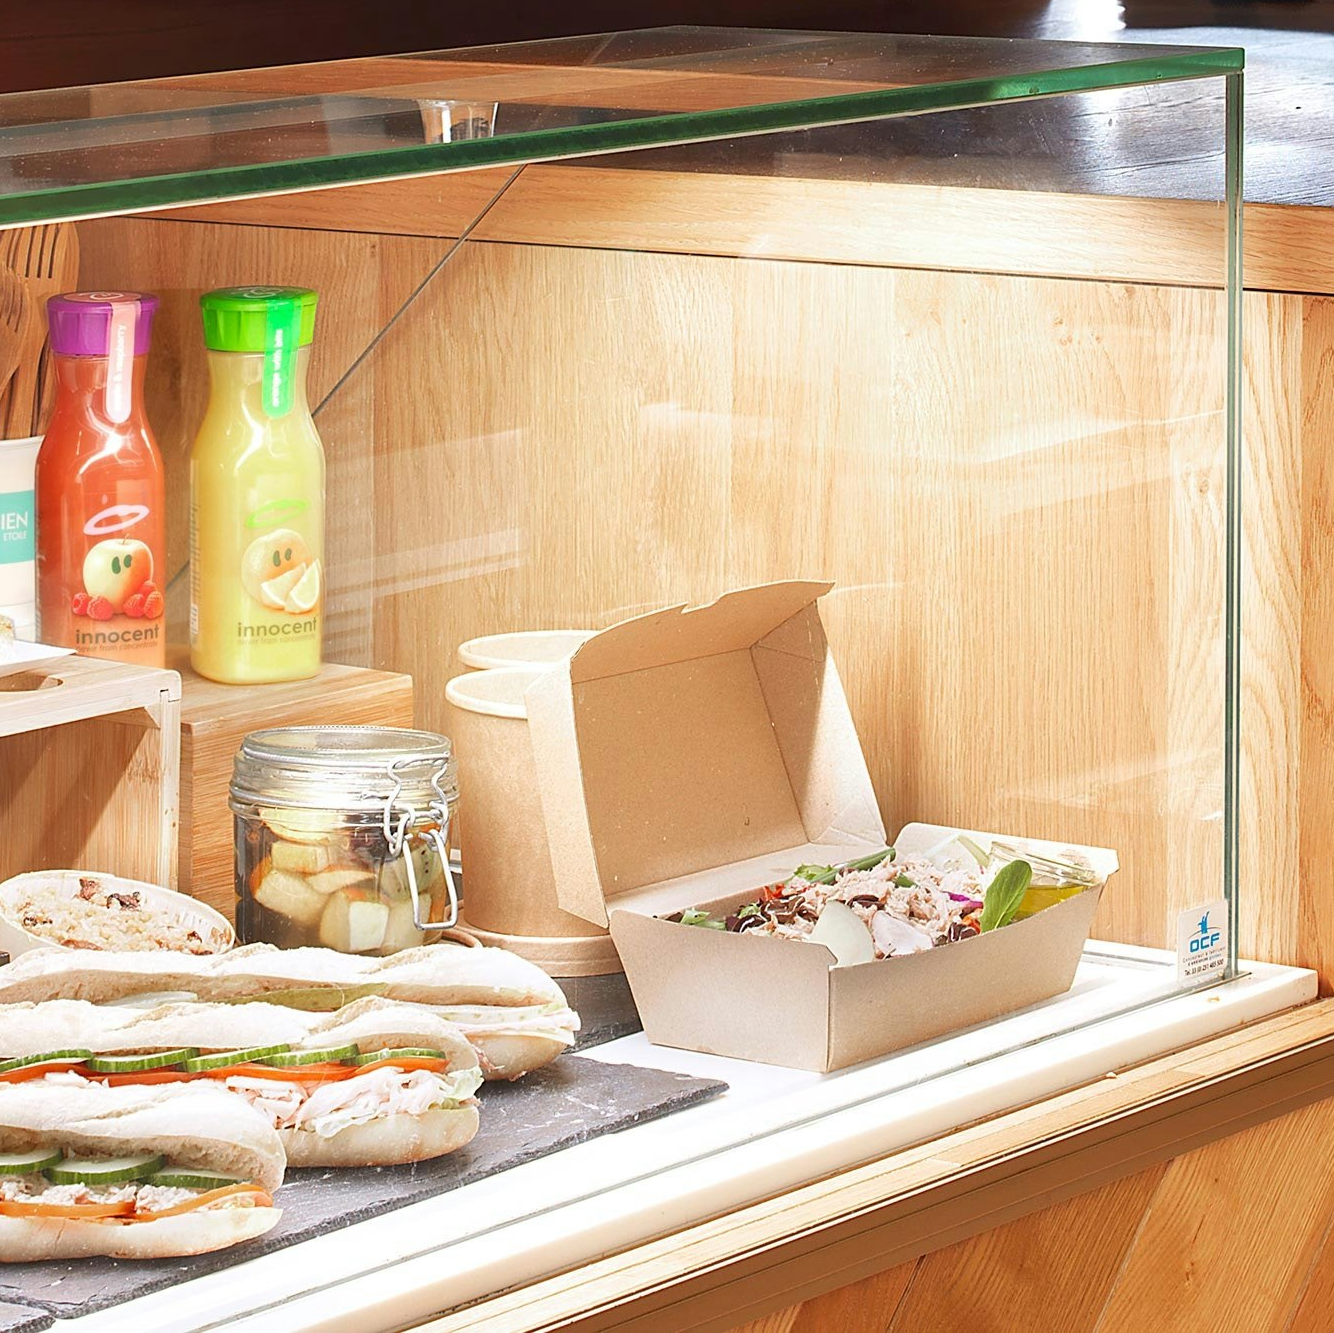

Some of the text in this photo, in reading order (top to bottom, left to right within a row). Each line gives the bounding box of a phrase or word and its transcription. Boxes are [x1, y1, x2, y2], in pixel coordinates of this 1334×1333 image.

[76, 624, 159, 644] innocent
[237, 617, 317, 637] innocent
[1189, 932, 1220, 953] OCF
